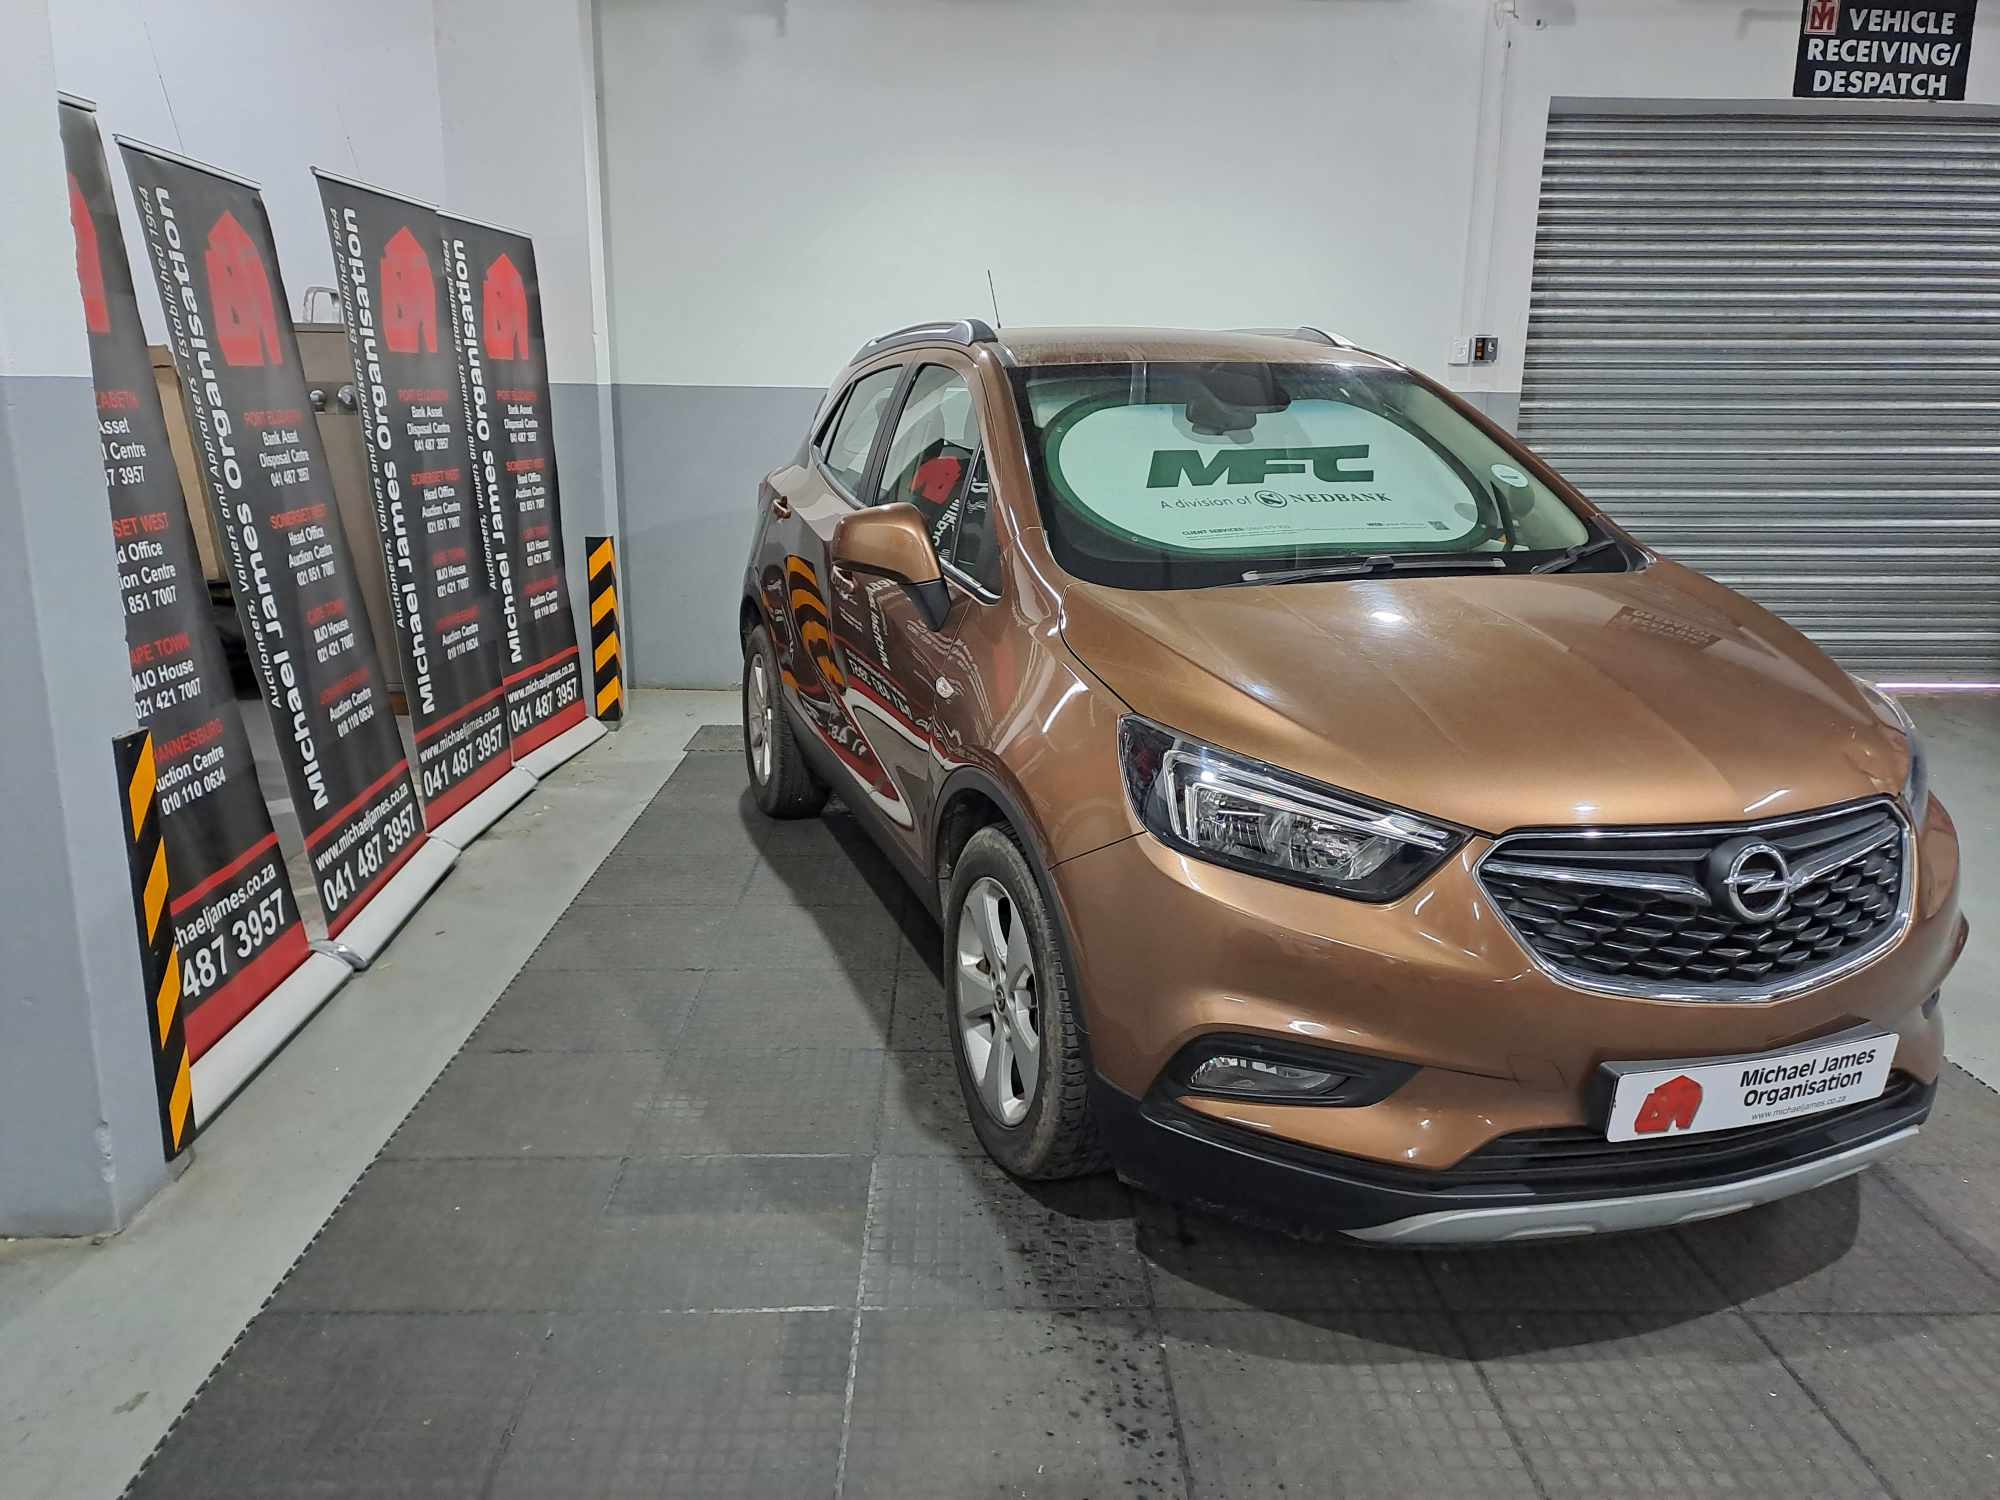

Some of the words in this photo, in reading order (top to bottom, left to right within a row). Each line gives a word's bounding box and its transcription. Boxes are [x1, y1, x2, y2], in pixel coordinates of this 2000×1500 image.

[1850, 8, 1956, 35] VEHICLE
[1807, 38, 1962, 67] RECEIVING/
[1813, 69, 1948, 97] DESPATCH
[138, 185, 160, 237] 1964
[151, 242, 190, 358] Established
[155, 187, 242, 489] Organisation
[343, 208, 392, 451] Organisation
[453, 239, 490, 442] Organisation
[187, 376, 223, 478] Appraisers
[119, 466, 145, 486] 3957
[366, 443, 379, 473] and
[1146, 444, 1374, 488] MFC
[141, 512, 169, 532] WEST
[213, 483, 230, 518] and
[373, 478, 389, 533] Valuers
[384, 461, 413, 573] James
[482, 450, 505, 544] James
[1161, 500, 1172, 509] A
[1175, 495, 1234, 508] division
[1239, 494, 1252, 505] of
[1288, 492, 1392, 502] NEDBANK
[128, 541, 163, 561] Office
[141, 563, 176, 584] Centre
[225, 524, 249, 593] Valuers
[236, 502, 284, 638] James
[128, 591, 151, 614] 851
[152, 585, 177, 607] 7007
[495, 552, 522, 664] Michael
[158, 659, 194, 683] House
[402, 583, 435, 715] Michael
[135, 698, 154, 720] 021
[156, 688, 176, 710] 421
[178, 677, 201, 700] 7007
[507, 662, 575, 703] www.michaeljames.co.za
[510, 702, 533, 733] 041
[535, 691, 553, 719] 487
[556, 677, 577, 708] 3957
[273, 650, 329, 811] Michael
[420, 706, 500, 764] www.michaeljames.co.za
[193, 745, 225, 772] Centre
[423, 760, 449, 798] 041
[452, 742, 473, 777] 487
[475, 724, 503, 761] 3957
[161, 795, 181, 816] 010
[182, 783, 202, 806] 110
[203, 766, 226, 793] 0634
[315, 782, 409, 872] www.michaeljames.co.za
[323, 861, 356, 912] 041
[357, 832, 383, 878] 487
[383, 803, 416, 853] 3957
[182, 934, 227, 998] 487
[232, 888, 285, 958] 3957
[1740, 1059, 1817, 1087] Michael
[1819, 1048, 1876, 1075] James
[1743, 1069, 1862, 1107] Organisation
